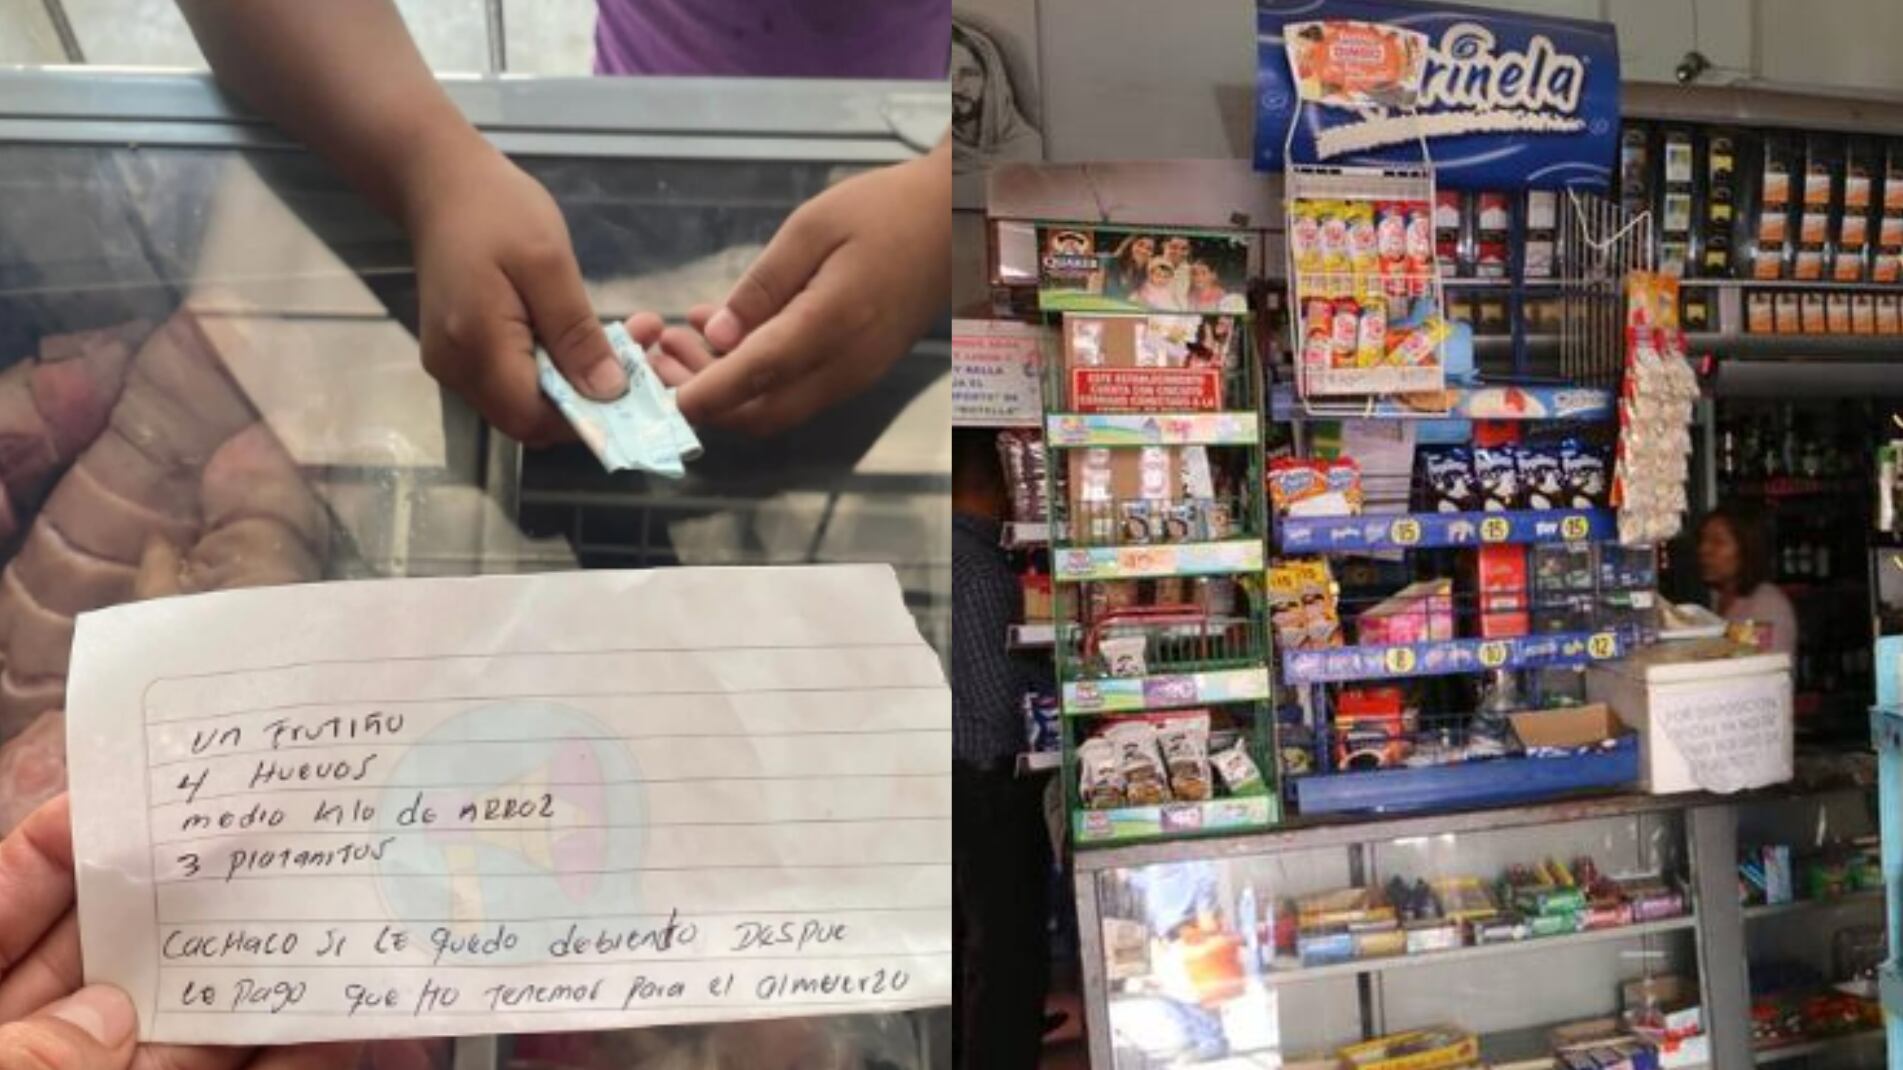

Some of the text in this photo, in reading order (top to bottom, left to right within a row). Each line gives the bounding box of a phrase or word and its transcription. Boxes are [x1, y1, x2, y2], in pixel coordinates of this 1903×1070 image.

[1418, 24, 1584, 114] rinela
[1043, 256, 1097, 269] QUAKER
[177, 768, 210, 803] 4
[396, 790, 437, 827] de
[177, 853, 201, 877] 3
[708, 972, 734, 996] el
